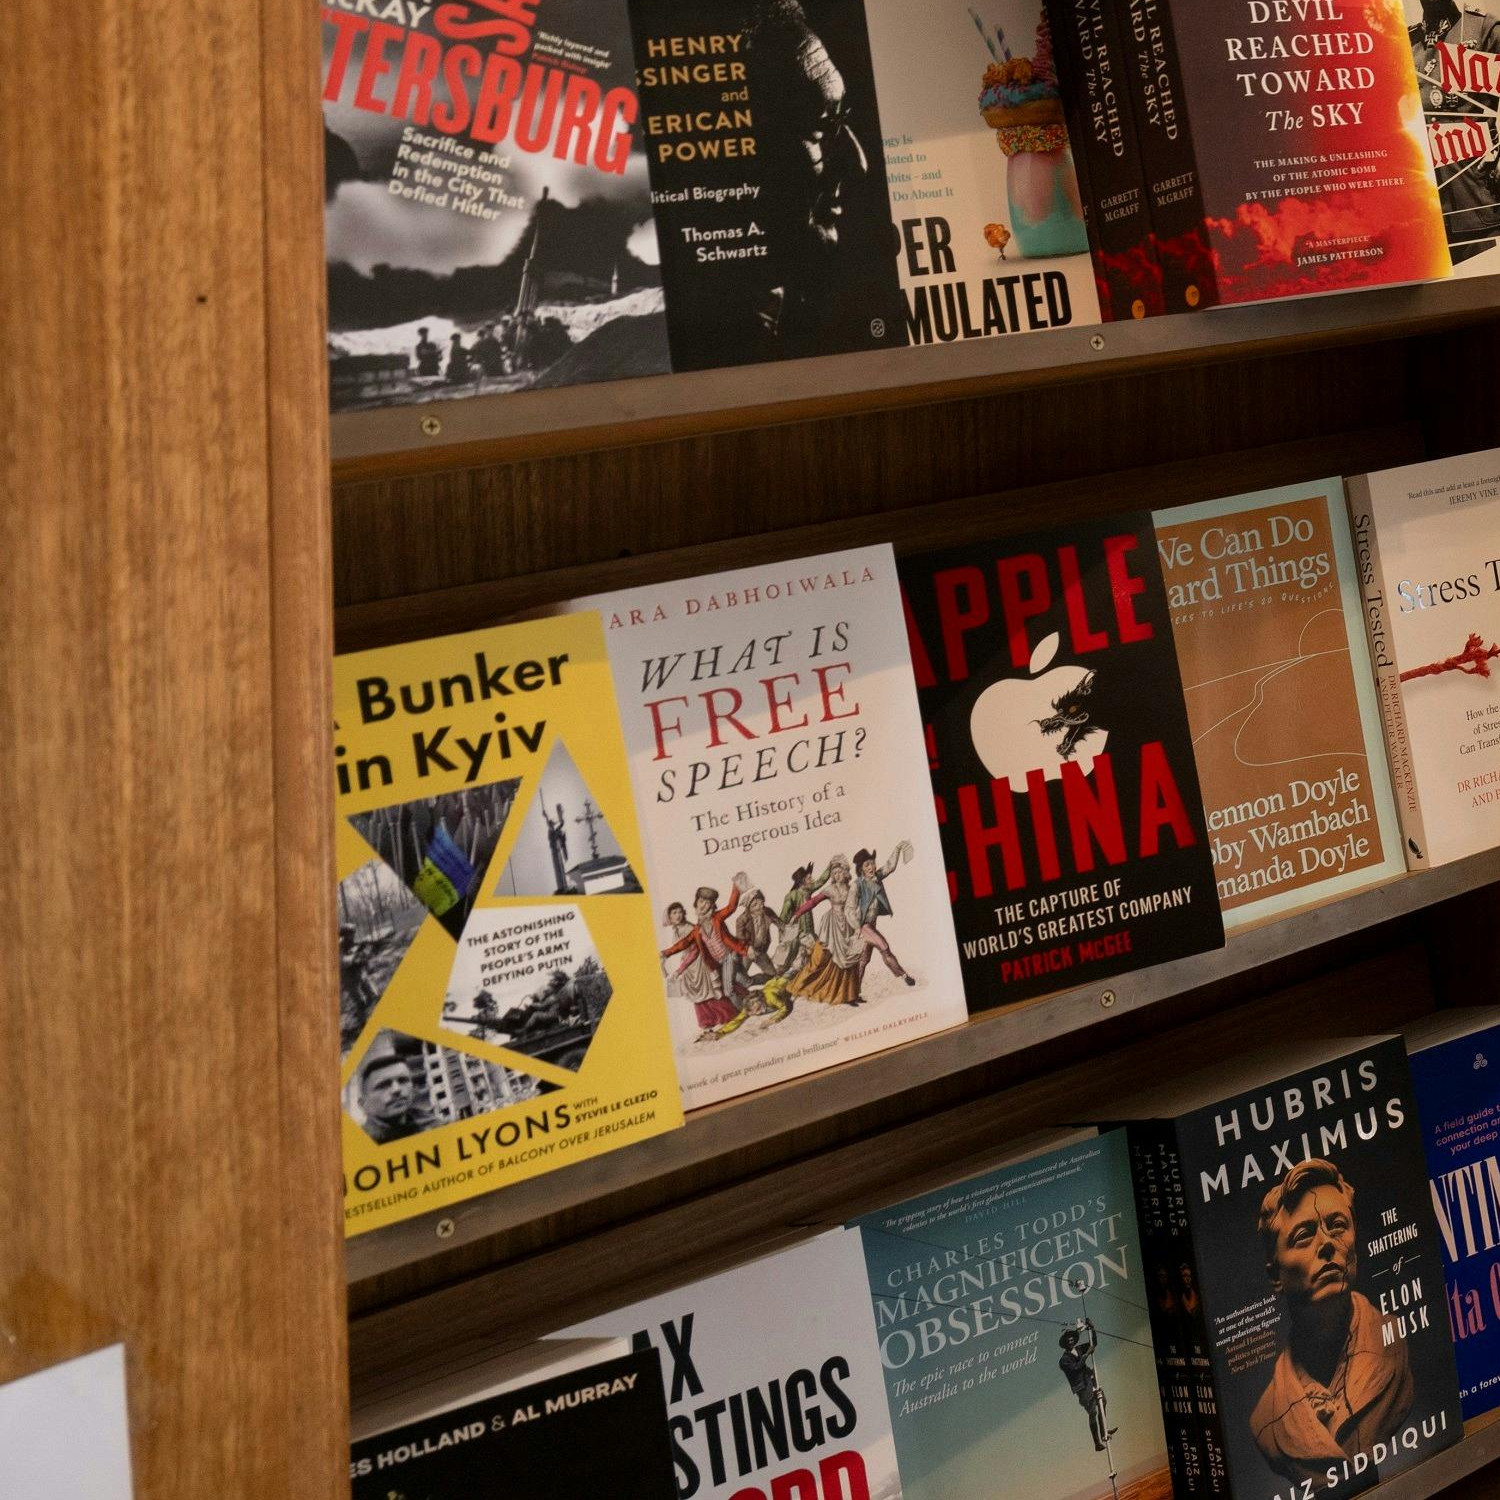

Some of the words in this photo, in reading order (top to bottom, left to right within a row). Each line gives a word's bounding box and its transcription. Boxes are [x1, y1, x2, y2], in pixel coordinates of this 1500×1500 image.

[648, 34, 742, 57] HENRY
[1224, 32, 1374, 60] REACHED
[1236, 67, 1376, 97] TOWARD
[1265, 110, 1304, 132] The
[1310, 102, 1365, 127] SKY
[658, 136, 757, 163] POWER
[681, 227, 742, 242] Thomas
[747, 222, 765, 236] A.
[696, 245, 768, 262] Schwartz
[1395, 568, 1481, 615] Stress
[641, 630, 802, 692] WHAT
[808, 620, 851, 660] IS
[356, 651, 571, 724] Bunker
[643, 661, 861, 760] FREE
[339, 746, 394, 794] in
[414, 711, 547, 783] Kyiv
[656, 726, 868, 804] SPEECH?
[702, 818, 799, 856] Dangerous
[804, 808, 843, 833] Idea
[963, 926, 1033, 960] WORLD'S
[1036, 906, 1116, 945] GREATEST
[1119, 886, 1193, 926] COMPANY
[995, 904, 1024, 926] THE
[1027, 885, 1093, 919] CAPTURE
[1096, 877, 1122, 900] OF
[1214, 1059, 1379, 1147] HUBRIS
[1199, 1097, 1406, 1203] MAXIMUS
[1379, 1276, 1424, 1316] ELON
[1381, 1309, 1430, 1348] MUSK
[377, 1421, 485, 1469] HOLLAND
[490, 1415, 505, 1431] &
[511, 1407, 541, 1426] AL
[545, 1372, 639, 1419] MURRAY
[1324, 1409, 1449, 1489] SIDDIQUI
